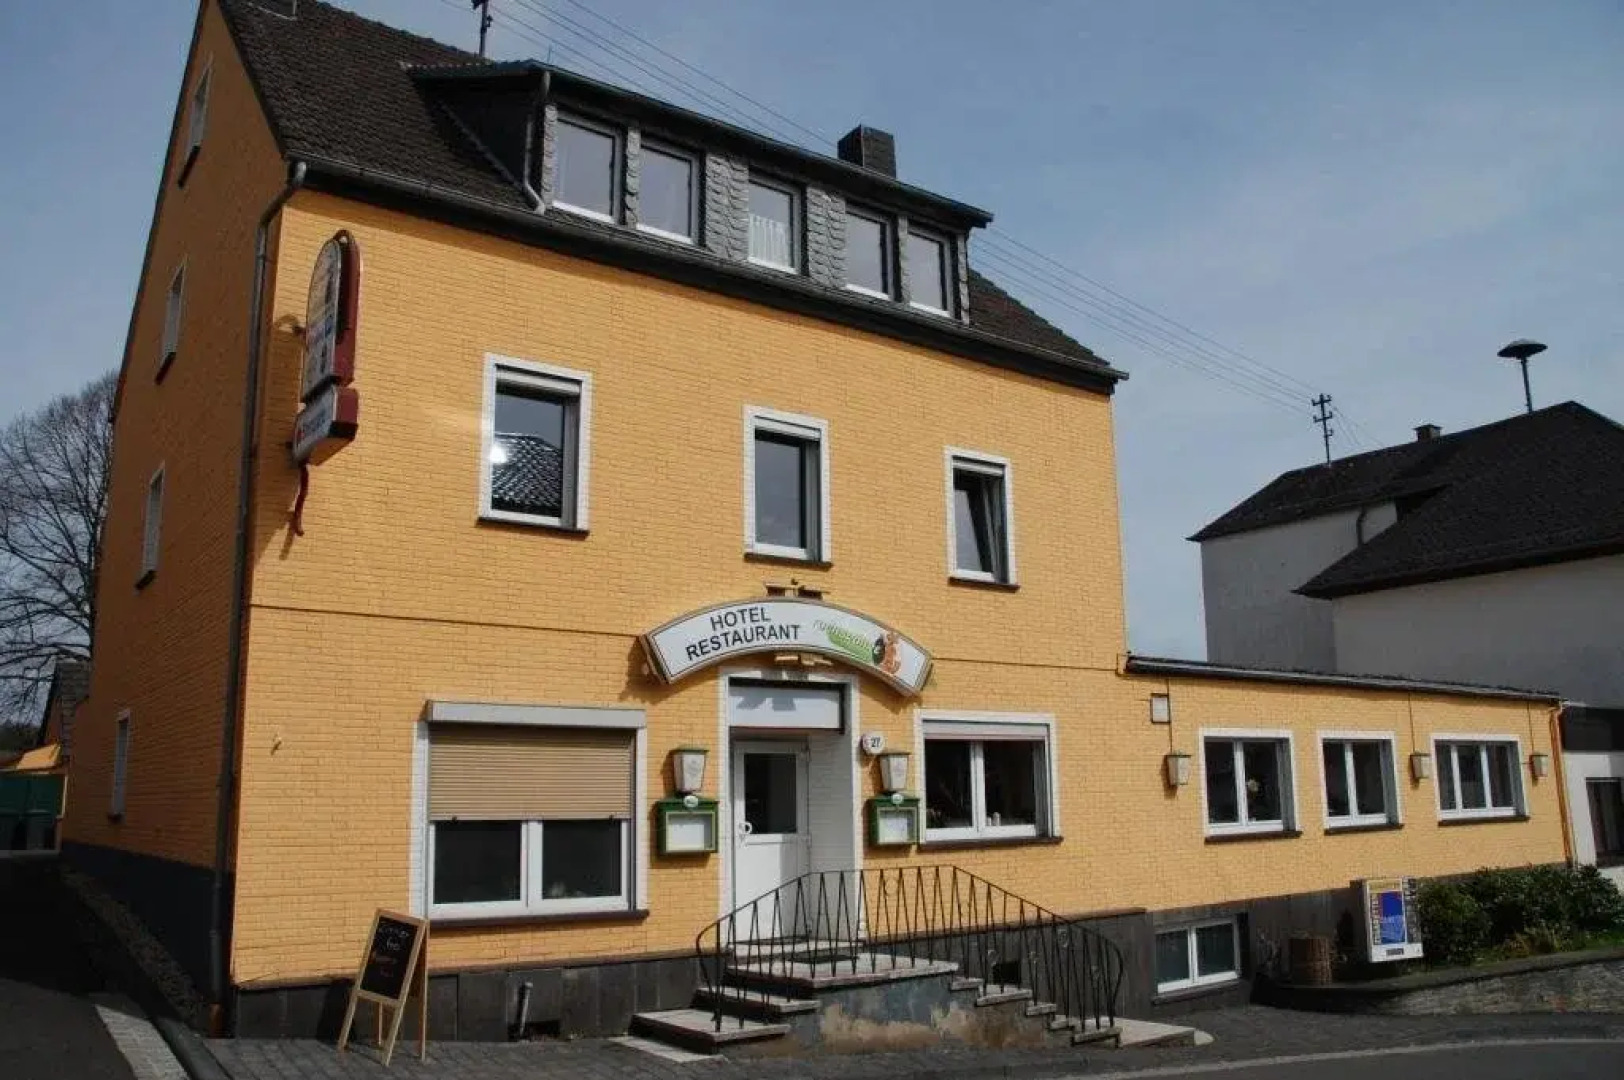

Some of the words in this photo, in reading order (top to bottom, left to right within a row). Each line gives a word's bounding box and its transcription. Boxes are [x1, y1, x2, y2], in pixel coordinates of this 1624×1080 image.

[710, 606, 772, 632] HOTEL
[685, 624, 800, 661] RESTAURANT
[870, 736, 881, 748] 27
